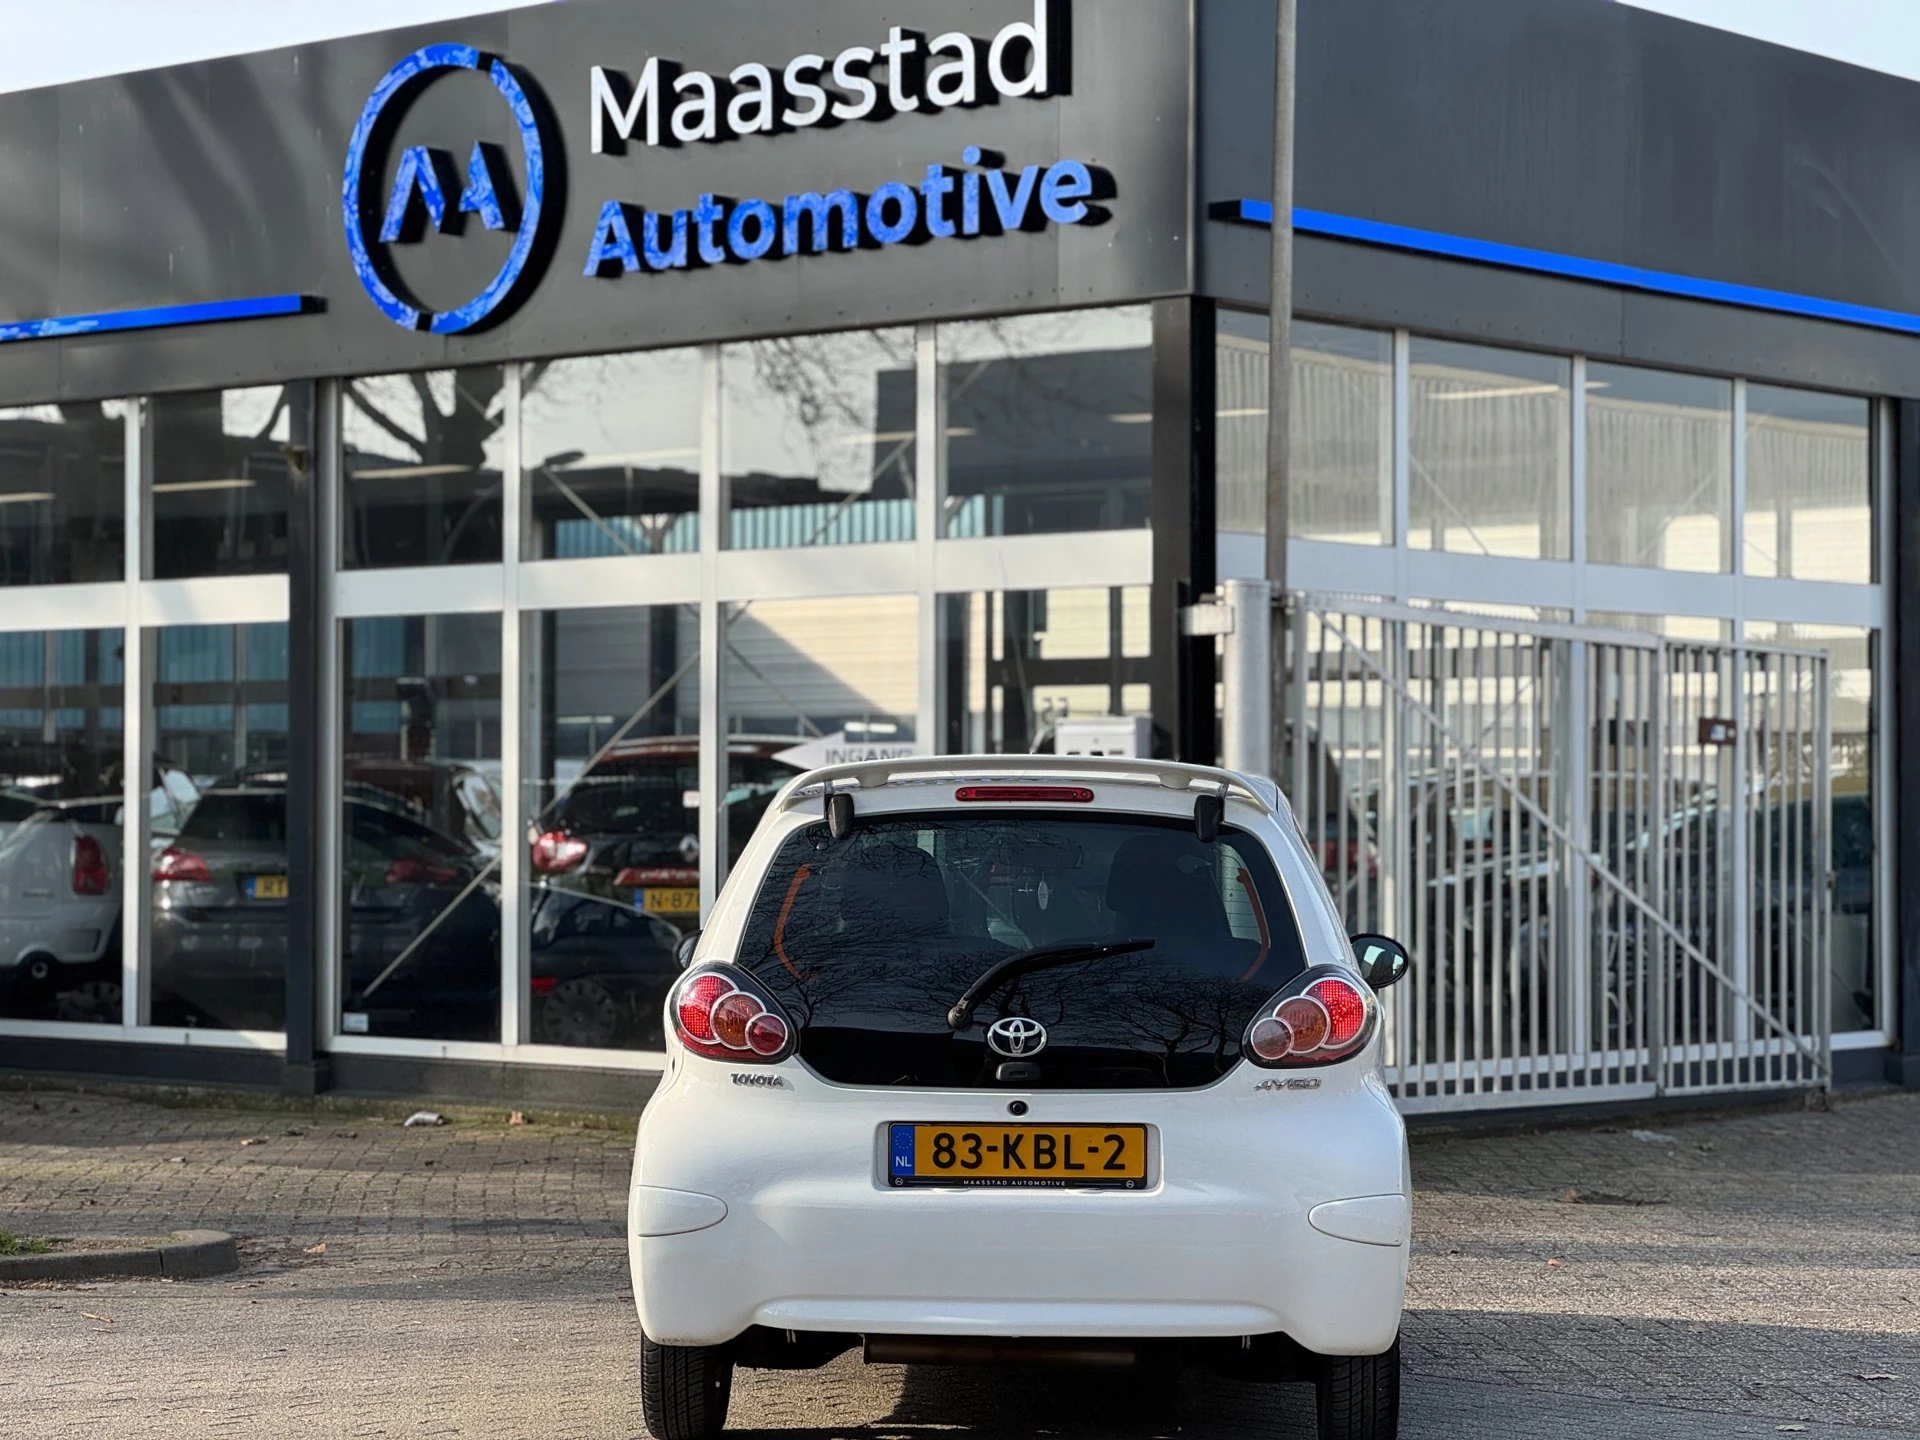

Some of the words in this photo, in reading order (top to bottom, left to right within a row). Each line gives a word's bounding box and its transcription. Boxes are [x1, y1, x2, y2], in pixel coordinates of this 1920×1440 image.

[591, 0, 1049, 154] Maasstad
[583, 145, 1094, 278] Automotive
[730, 1073, 784, 1087] TOYOTA
[1253, 1077, 1321, 1091] AYGO
[932, 1133, 1126, 1171] 83-KBL-2
[895, 1155, 912, 1167] NL
[1011, 1179, 1066, 1187] AUTOMOTIVE
